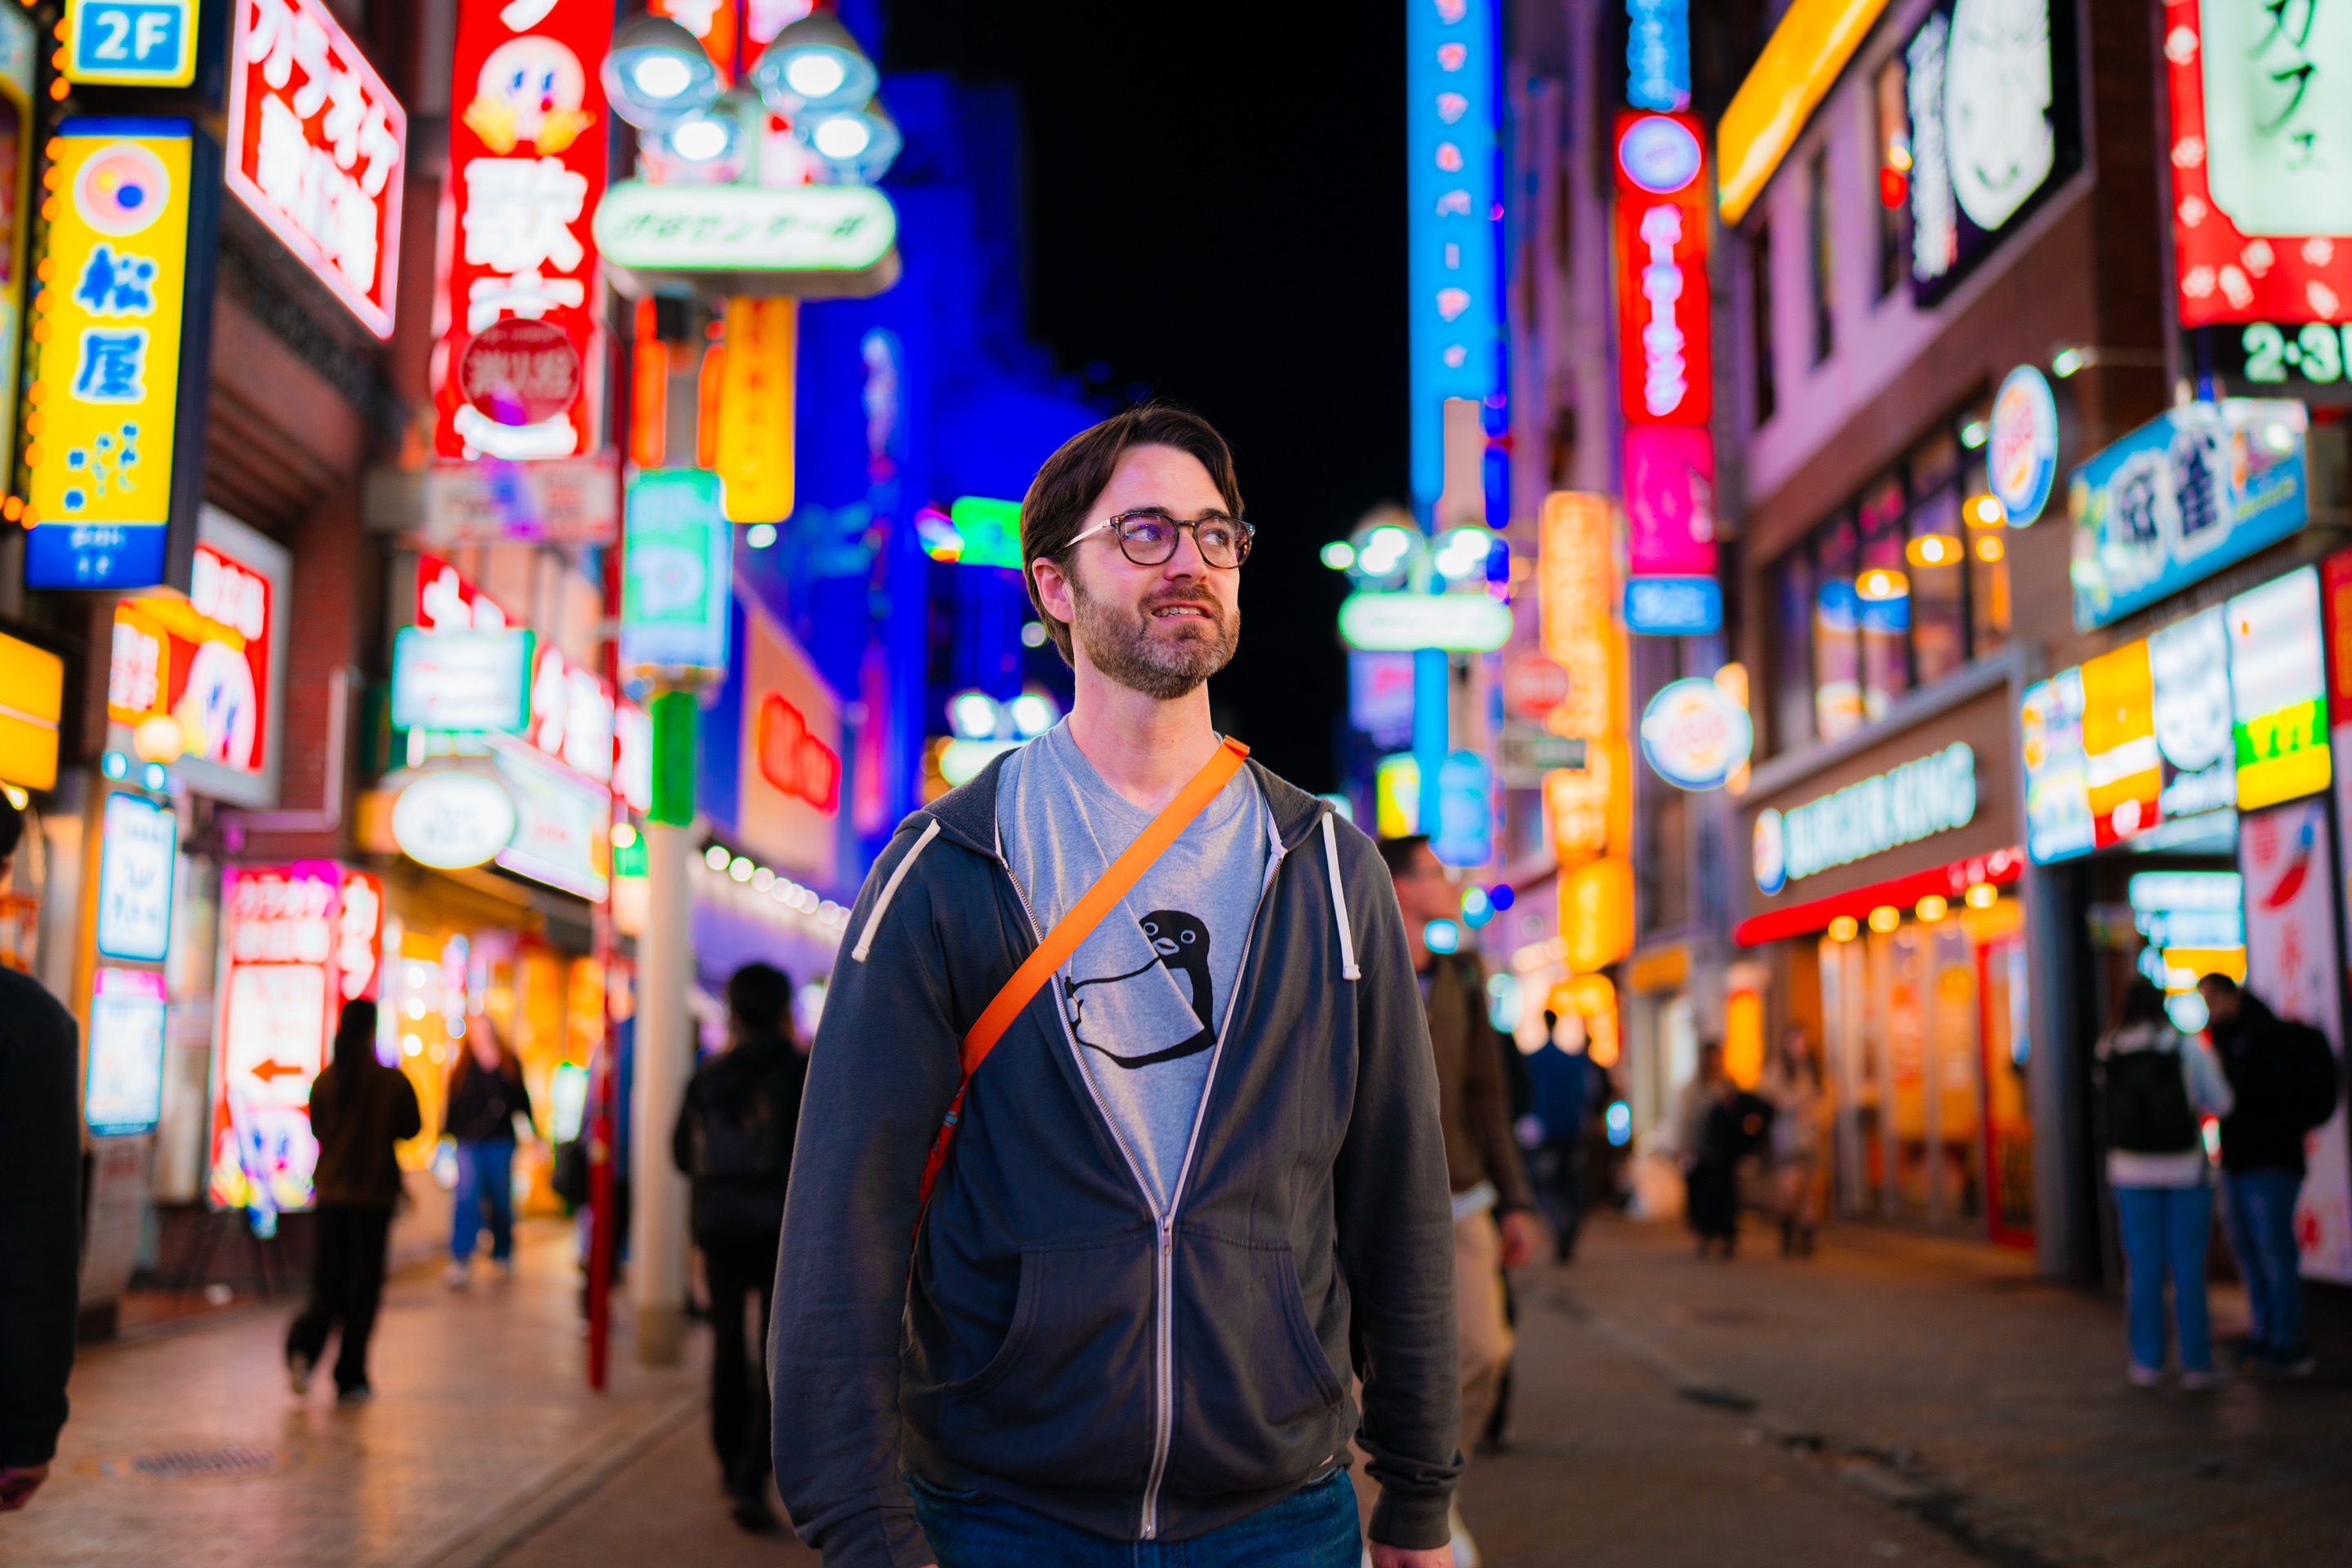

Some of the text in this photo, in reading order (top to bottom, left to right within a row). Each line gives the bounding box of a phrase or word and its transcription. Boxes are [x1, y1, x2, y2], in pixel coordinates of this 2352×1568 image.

[93, 11, 173, 60] 2F
[246, 0, 400, 198] カラオケ
[75, 244, 158, 403] 松屋
[2242, 323, 2352, 382] 2・3
[1890, 740, 1976, 848] KING
